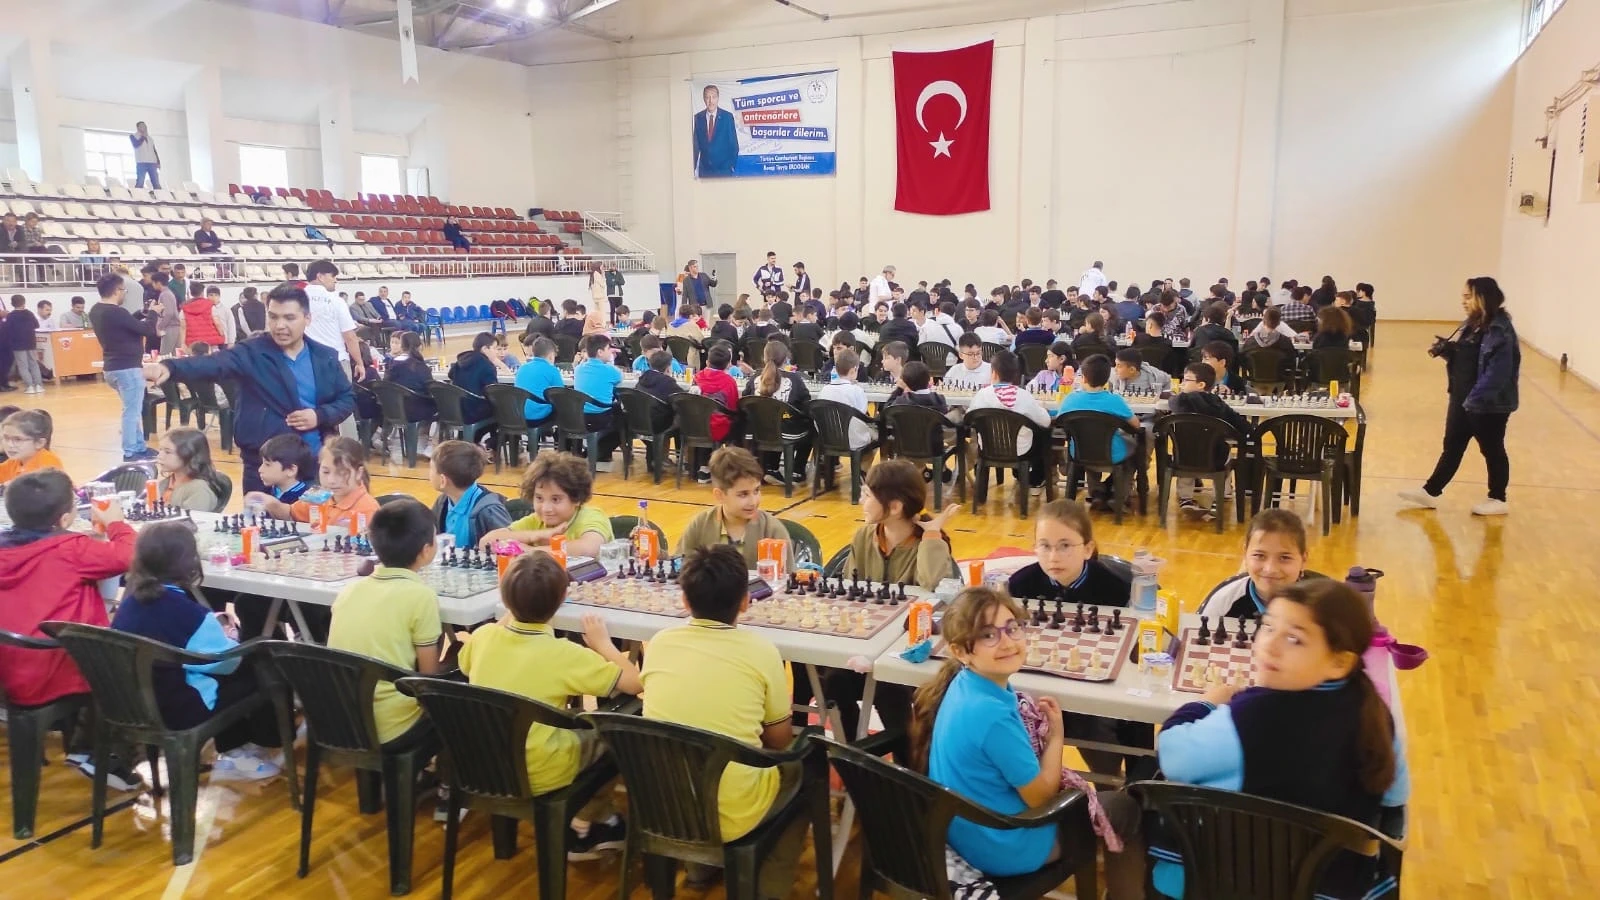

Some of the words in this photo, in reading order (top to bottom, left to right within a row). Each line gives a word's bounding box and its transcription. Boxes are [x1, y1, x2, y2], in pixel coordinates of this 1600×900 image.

[735, 98, 755, 108] Tüm
[757, 95, 786, 107] sporcu
[743, 109, 799, 121] antrenörlere
[752, 126, 790, 138] başarılar
[793, 127, 827, 138] dilerim.
